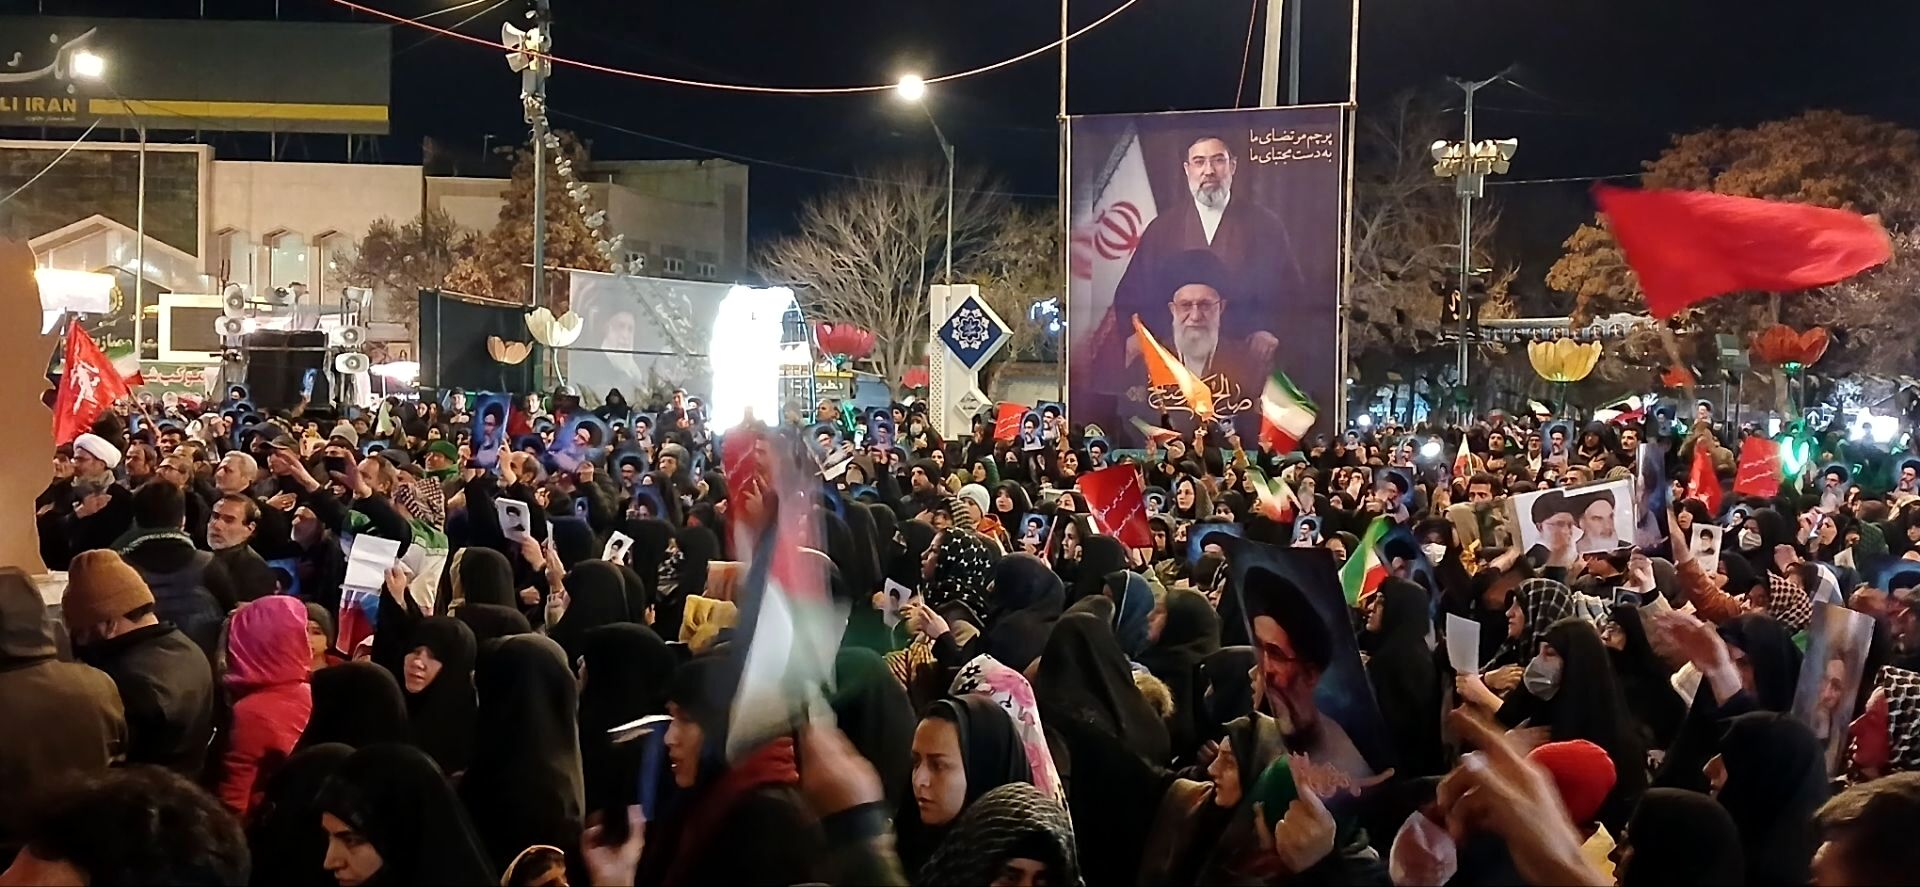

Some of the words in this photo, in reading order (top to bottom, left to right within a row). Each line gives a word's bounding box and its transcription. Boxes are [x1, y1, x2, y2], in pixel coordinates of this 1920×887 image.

[25, 96, 77, 113] IRAN
[1249, 128, 1259, 143] ما
[1259, 127, 1307, 145] مرتضای
[1306, 132, 1333, 149] پرچم
[1249, 147, 1259, 161] ما
[1258, 146, 1292, 165] مجتبای
[1292, 150, 1321, 160] دست
[1321, 149, 1333, 163] به
